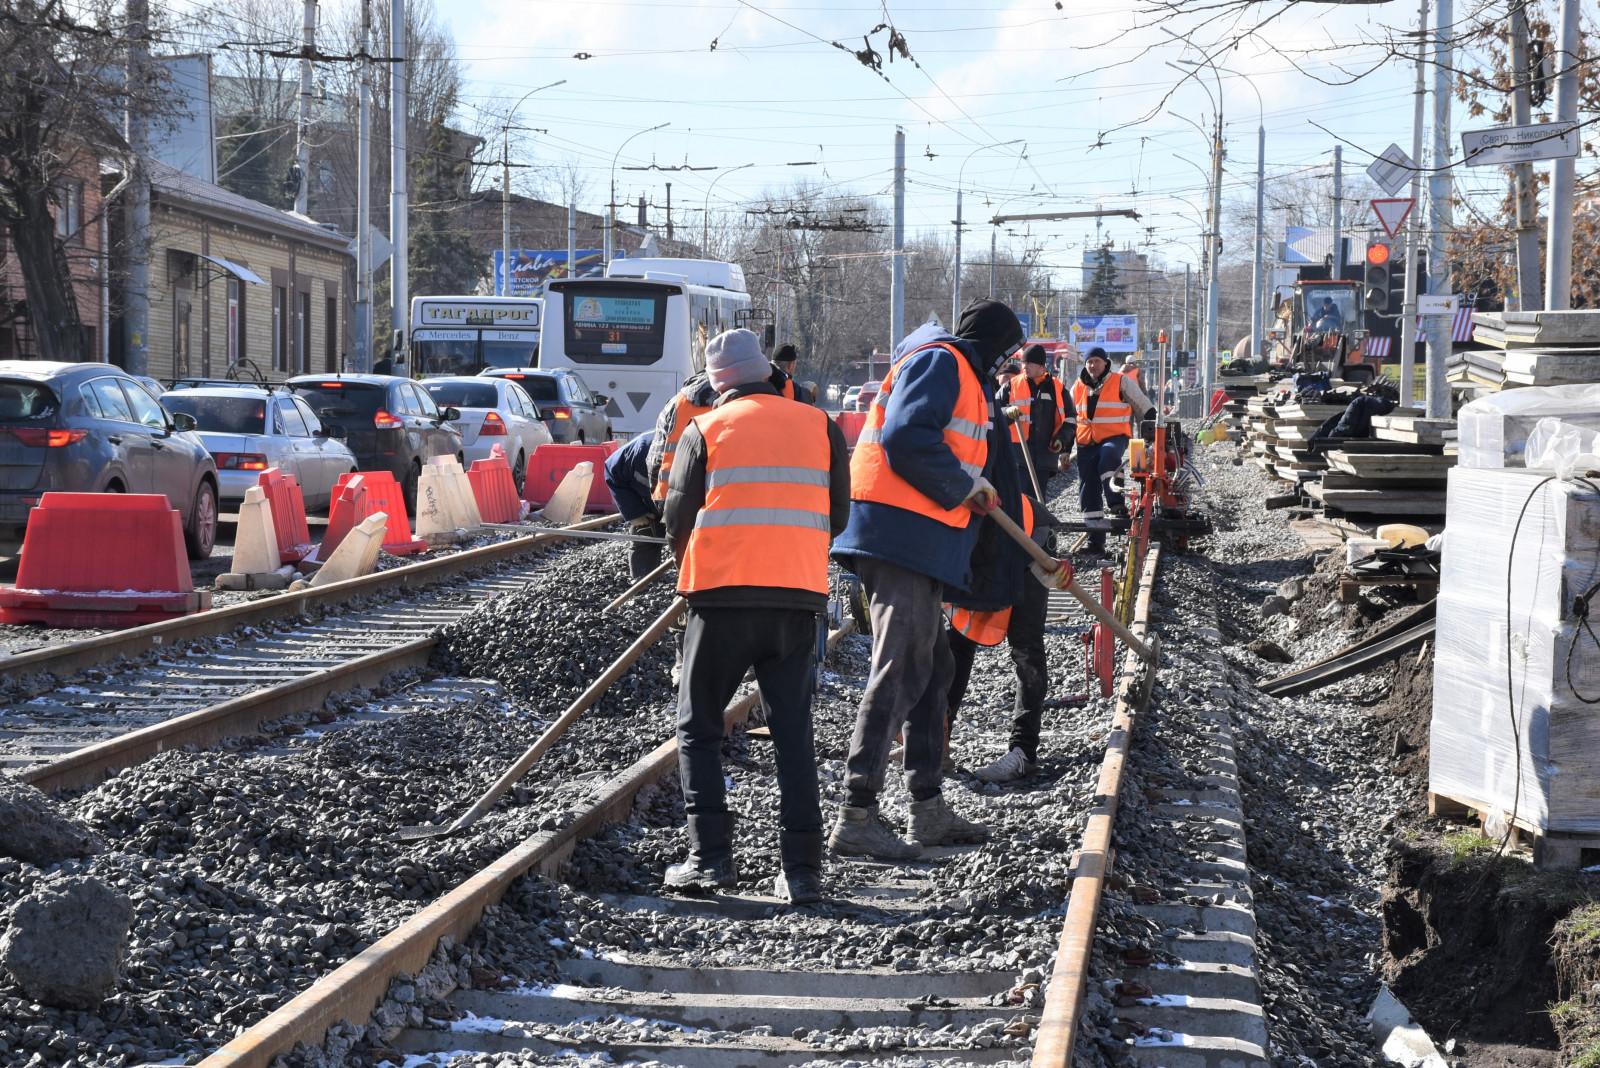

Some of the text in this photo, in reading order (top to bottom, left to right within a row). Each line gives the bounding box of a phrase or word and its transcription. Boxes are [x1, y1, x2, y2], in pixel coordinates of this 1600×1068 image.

[428, 307, 534, 320] ТАГАНРОГ
[428, 331, 520, 340] Mercedes Benz
[608, 330, 620, 342] 31
